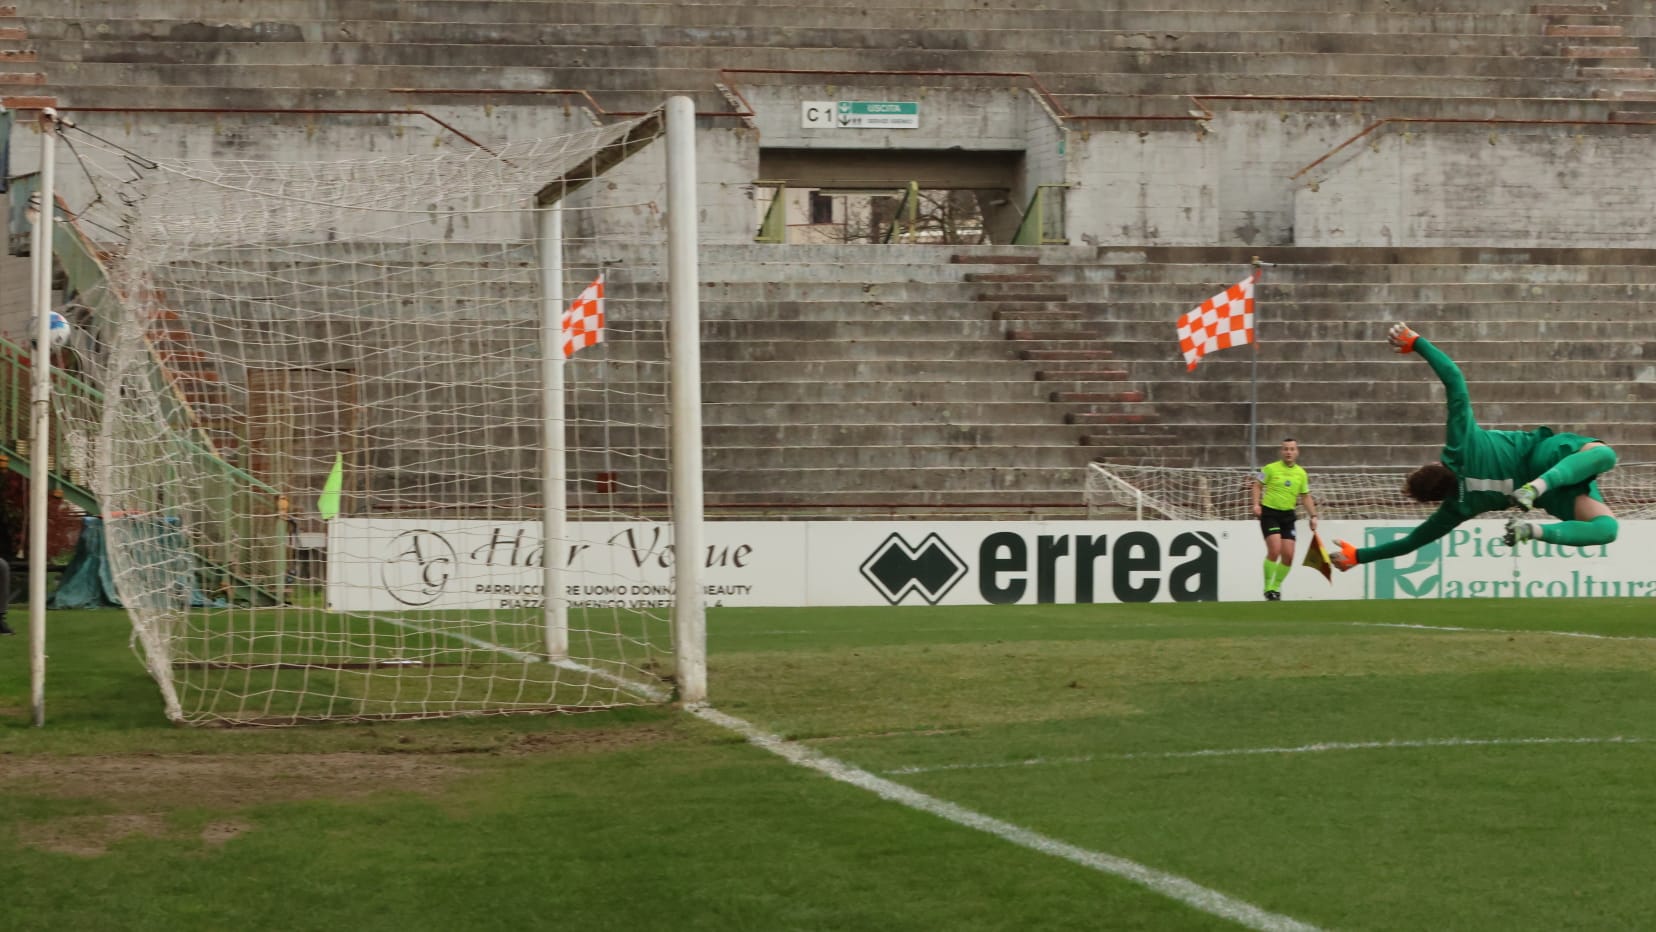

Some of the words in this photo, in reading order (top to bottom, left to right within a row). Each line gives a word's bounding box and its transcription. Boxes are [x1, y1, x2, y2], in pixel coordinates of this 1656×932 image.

[807, 107, 818, 122] C
[824, 108, 832, 122] 1
[470, 527, 591, 567] Har
[607, 526, 754, 576] Voue
[475, 584, 581, 596] PARRUCCRE
[584, 585, 627, 596] UOMO
[567, 599, 626, 608] MENICO
